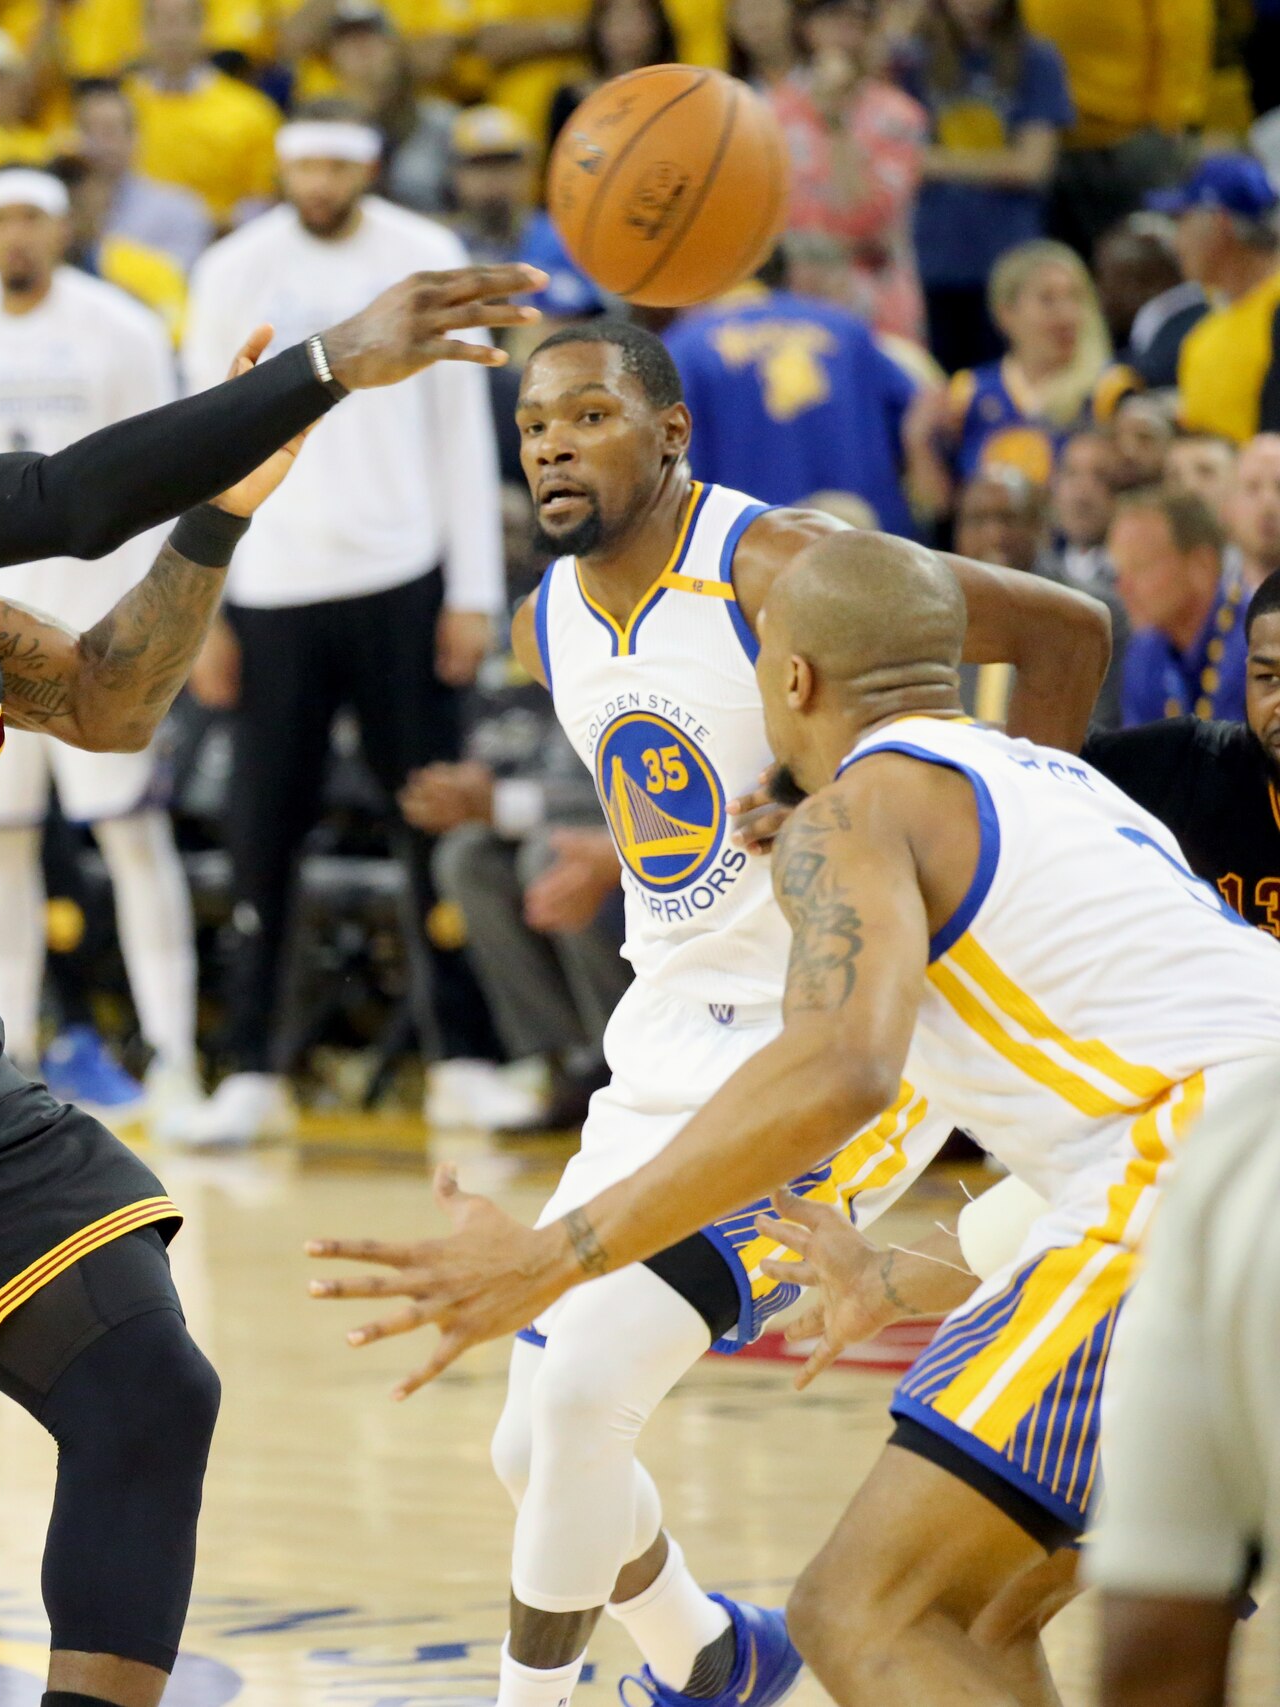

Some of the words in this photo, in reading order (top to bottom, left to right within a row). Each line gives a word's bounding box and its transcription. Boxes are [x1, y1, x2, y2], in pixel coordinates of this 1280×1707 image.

[587, 692, 640, 754] GOLDEN
[648, 694, 711, 743] STATE
[641, 744, 689, 795] 35
